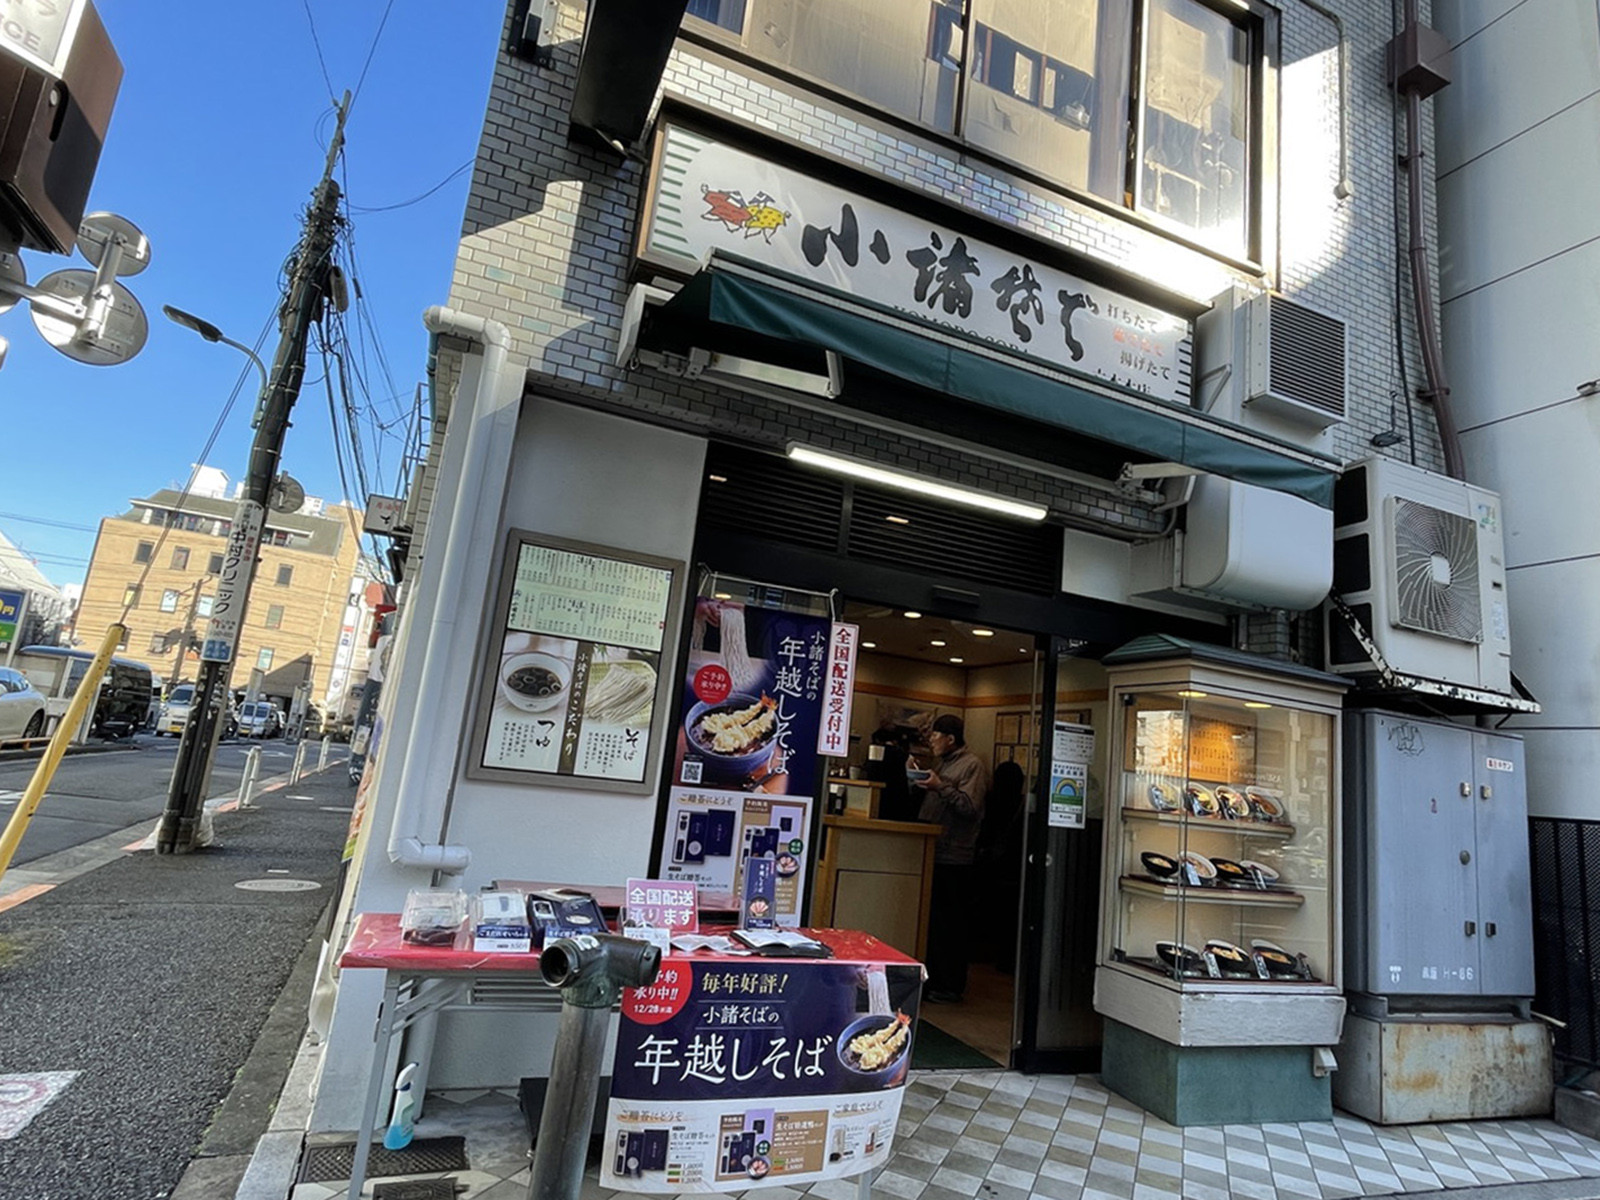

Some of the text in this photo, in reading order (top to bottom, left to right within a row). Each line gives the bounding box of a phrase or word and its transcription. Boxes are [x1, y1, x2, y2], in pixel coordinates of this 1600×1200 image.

[806, 631, 826, 701] 小諸そばの
[825, 627, 852, 750] 全国配送受付中
[768, 636, 806, 775] 年越しそば
[630, 887, 694, 906] 全国配送
[703, 1006, 780, 1025] 小諸そばの
[633, 1033, 833, 1086] 年越しそば
